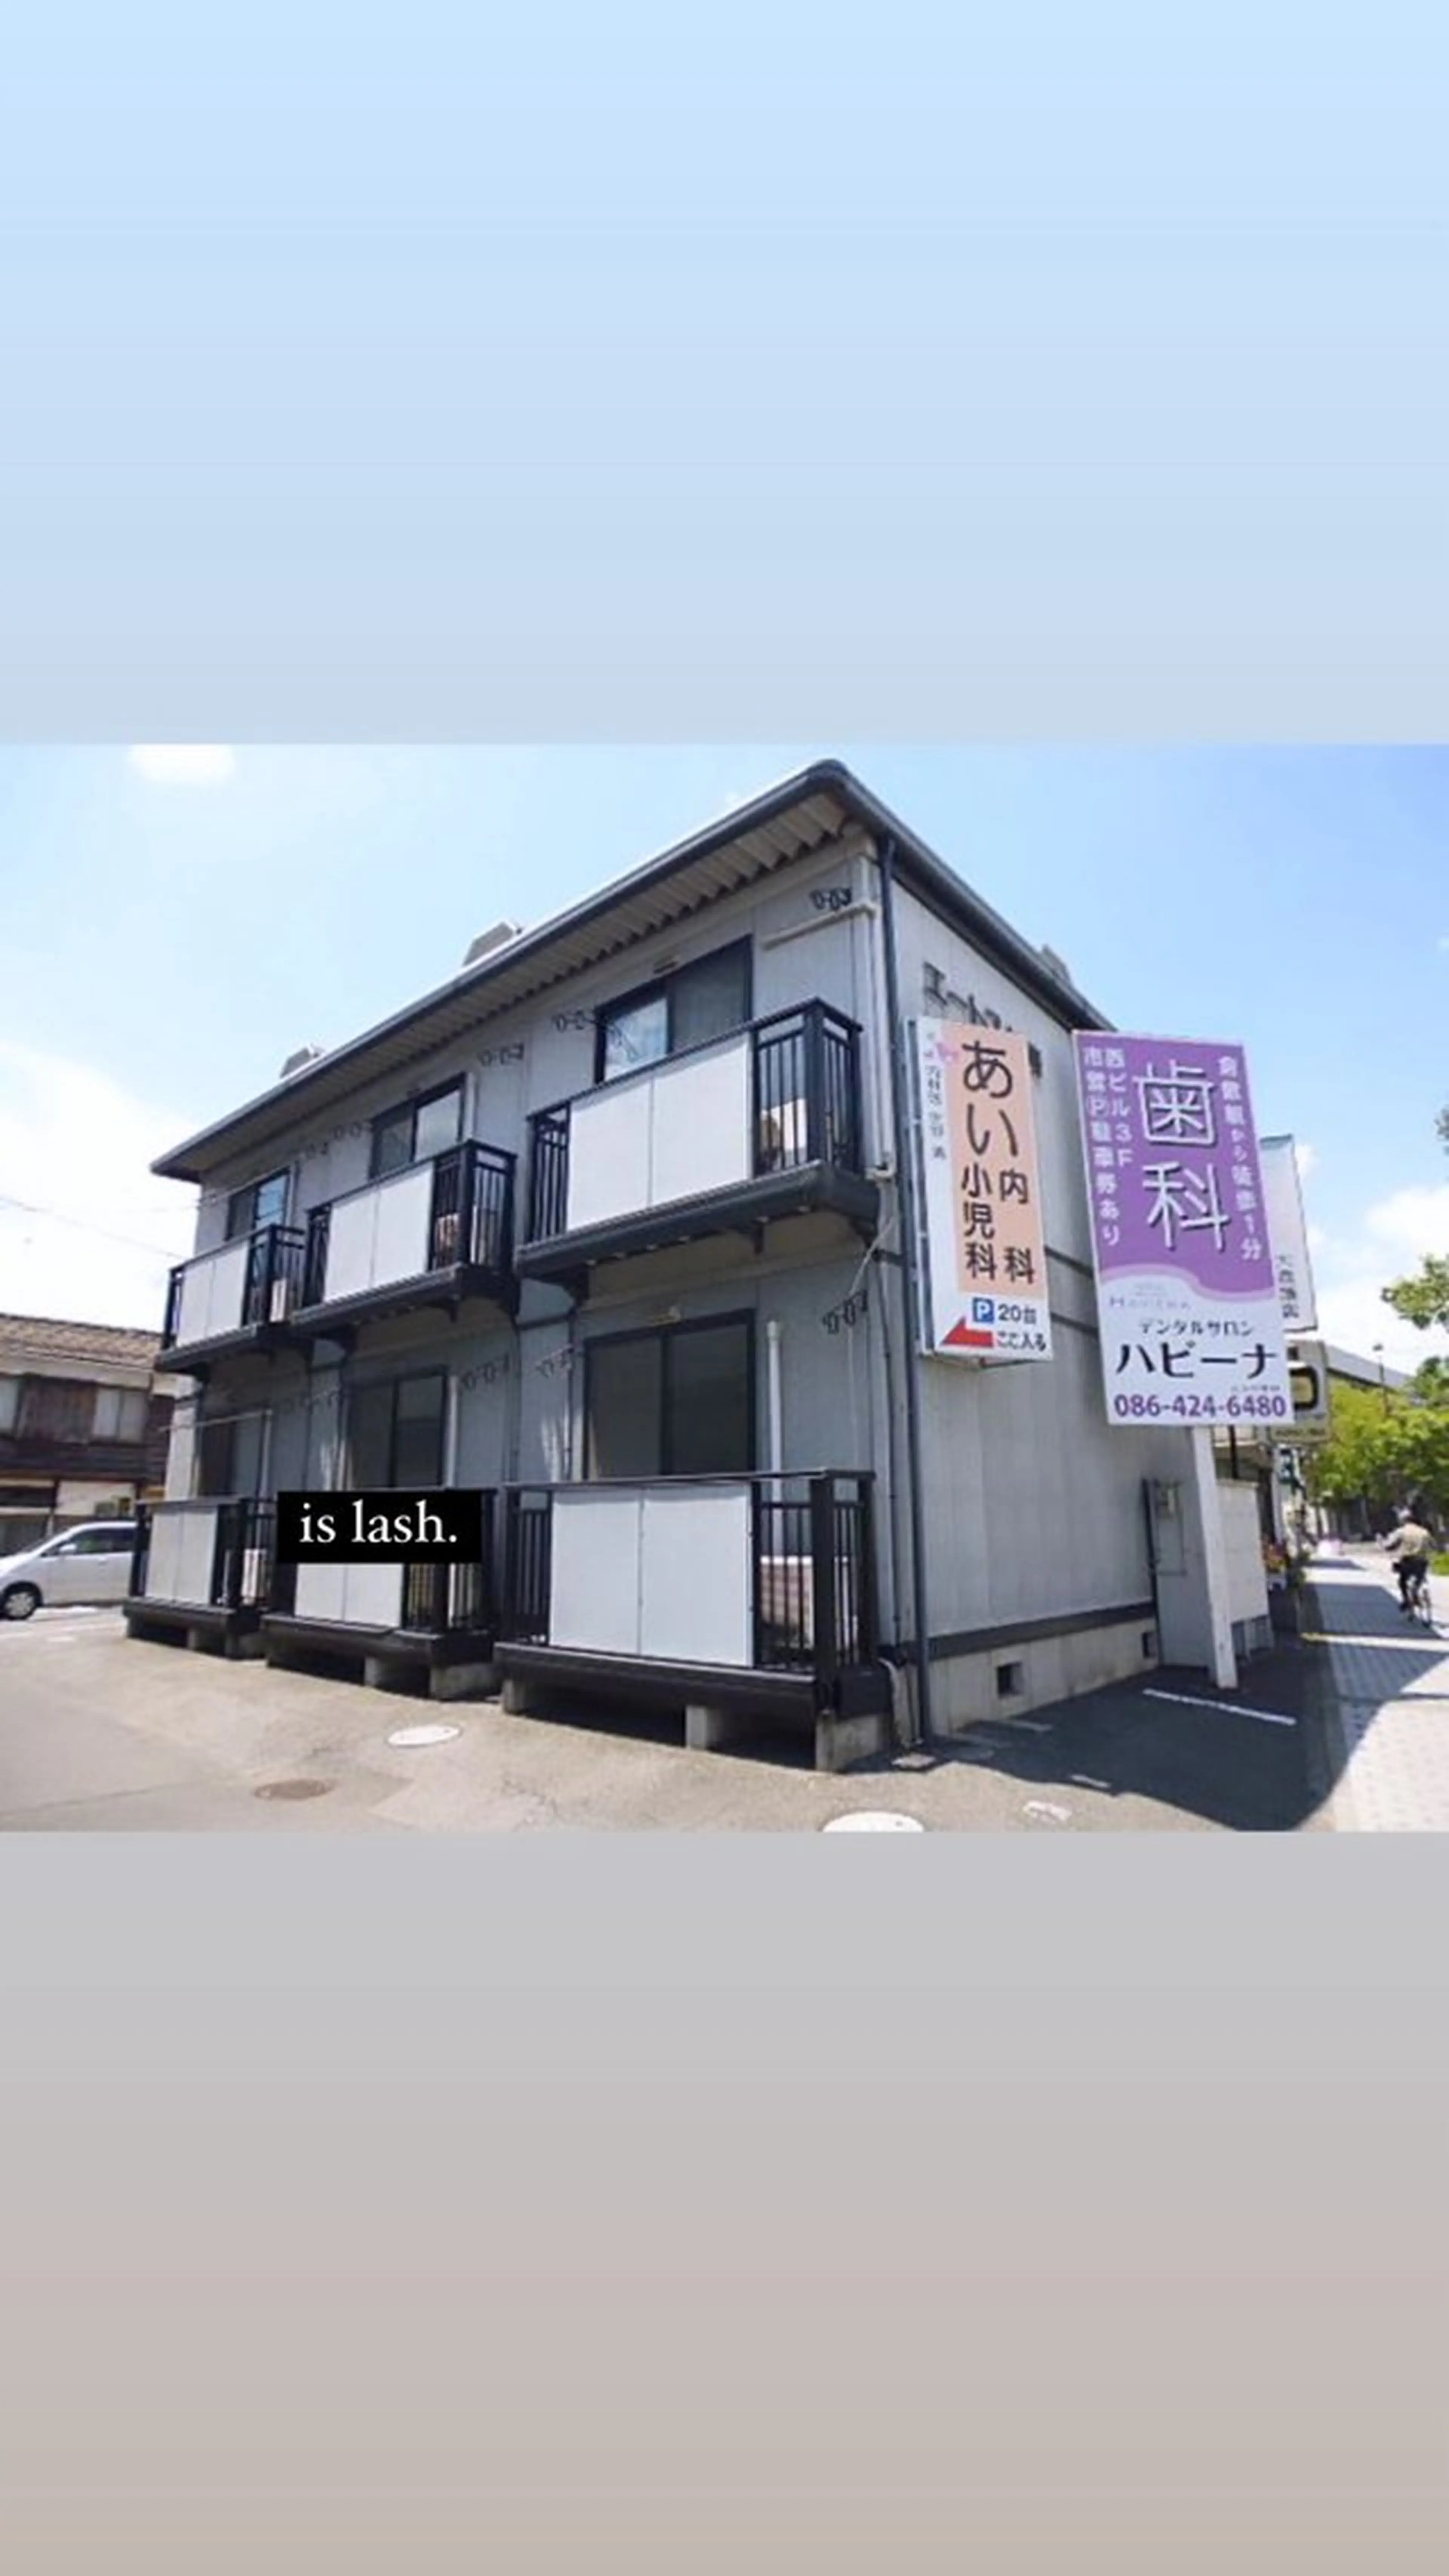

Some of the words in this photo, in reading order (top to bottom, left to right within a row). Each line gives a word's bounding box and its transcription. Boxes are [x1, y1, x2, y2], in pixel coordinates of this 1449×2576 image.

[961, 1040, 1017, 1157] あい
[1132, 1059, 1231, 1252] 歯科
[961, 1162, 997, 1281] 小児科
[1115, 1340, 1278, 1380] ハピーナ
[1139, 1320, 1255, 1336] デンタルサロン
[1114, 1393, 1287, 1417] 086-424-6480
